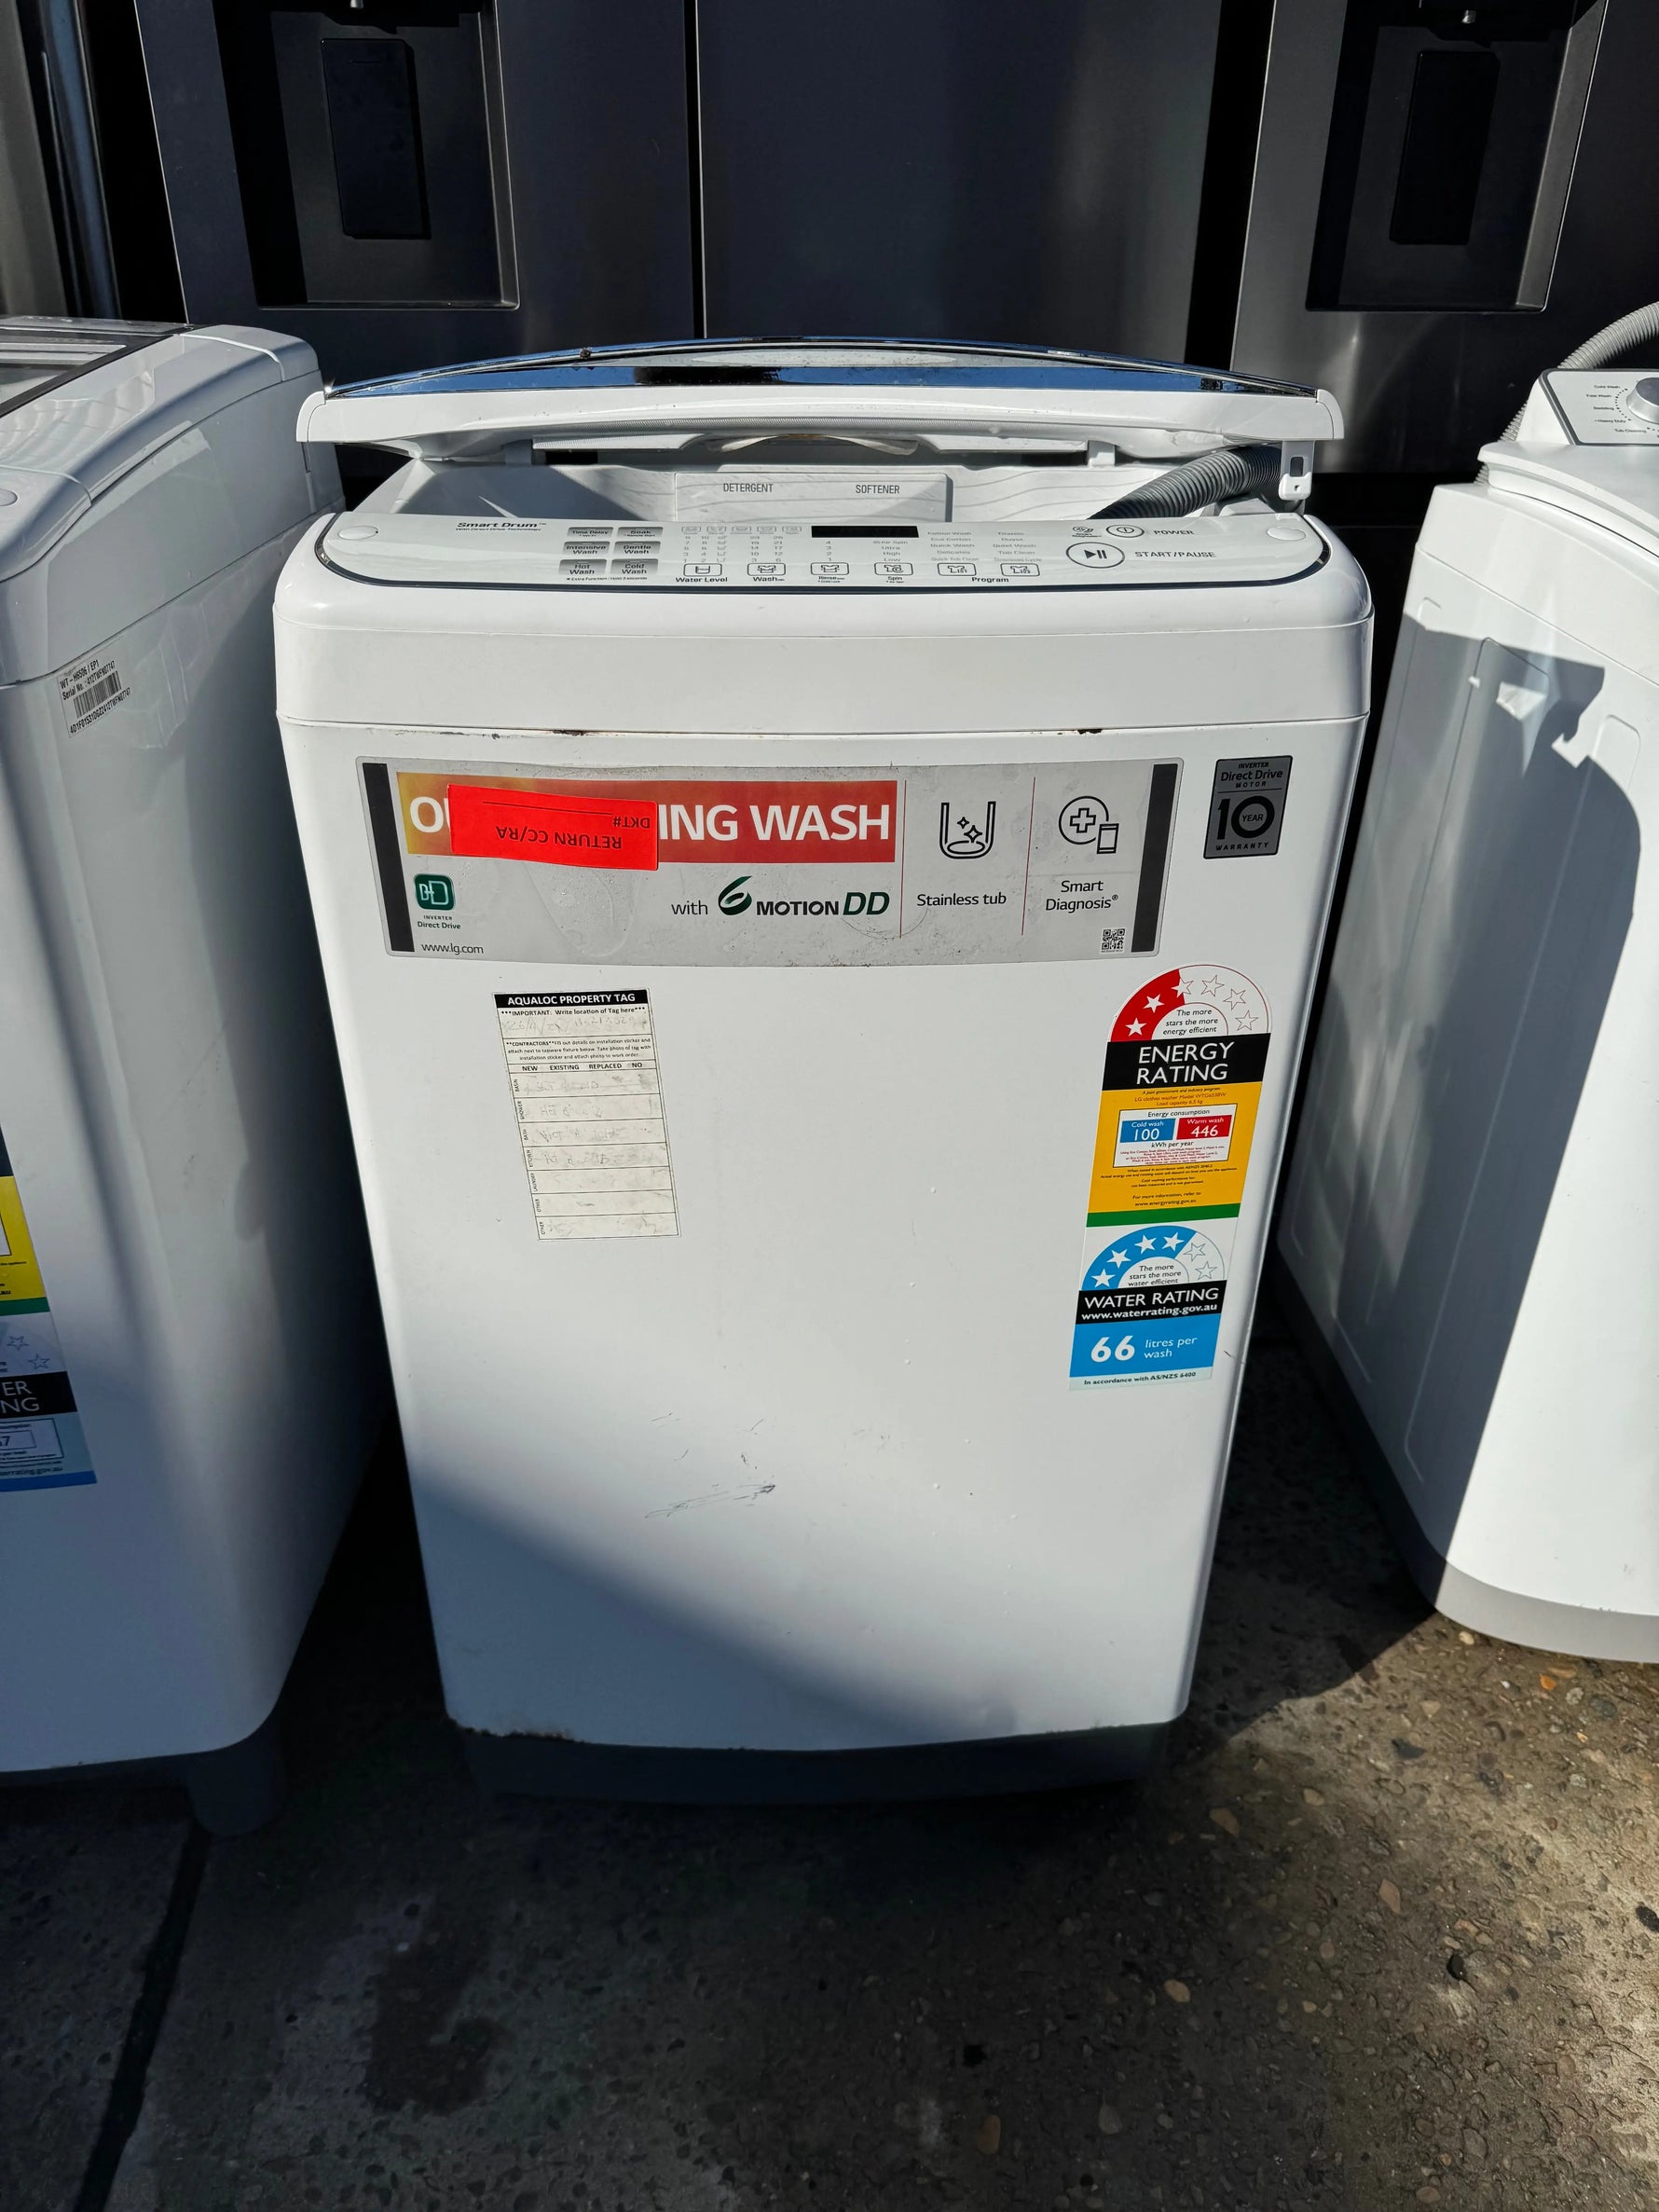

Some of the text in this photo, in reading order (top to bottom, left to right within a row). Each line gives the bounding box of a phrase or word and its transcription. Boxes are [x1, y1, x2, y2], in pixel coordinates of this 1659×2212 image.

[722, 482, 774, 494] DETERGENT
[855, 485, 900, 495] SOFTENER
[62, 686, 76, 700] Serial
[1220, 769, 1282, 781] Direct Drive
[613, 816, 651, 829] DKT#
[749, 804, 889, 841] WASH
[1216, 795, 1275, 840] 10
[1242, 814, 1264, 822] YEAR
[496, 825, 622, 849] RETURN CC/RA
[1215, 842, 1269, 851] WARRANTY
[1061, 880, 1104, 892] Smart
[671, 900, 708, 915] with
[756, 900, 839, 915] MOTION
[843, 891, 890, 915] DD
[917, 891, 1007, 906] Stainless tub
[421, 943, 484, 955] www.lg.com
[508, 993, 636, 1006] AQUALOC PROPERTY TAG
[1138, 1041, 1235, 1065] ENERGY
[1136, 1064, 1228, 1085] RATING
[1134, 1128, 1159, 1141] 100
[1191, 1125, 1218, 1138] 446
[1084, 1287, 1220, 1309] WATER RATING
[1081, 1303, 1217, 1321] www.waterrating.gov.au
[1090, 1335, 1135, 1363] 66
[1145, 1337, 1198, 1349] litres per
[1144, 1349, 1172, 1359] wash
